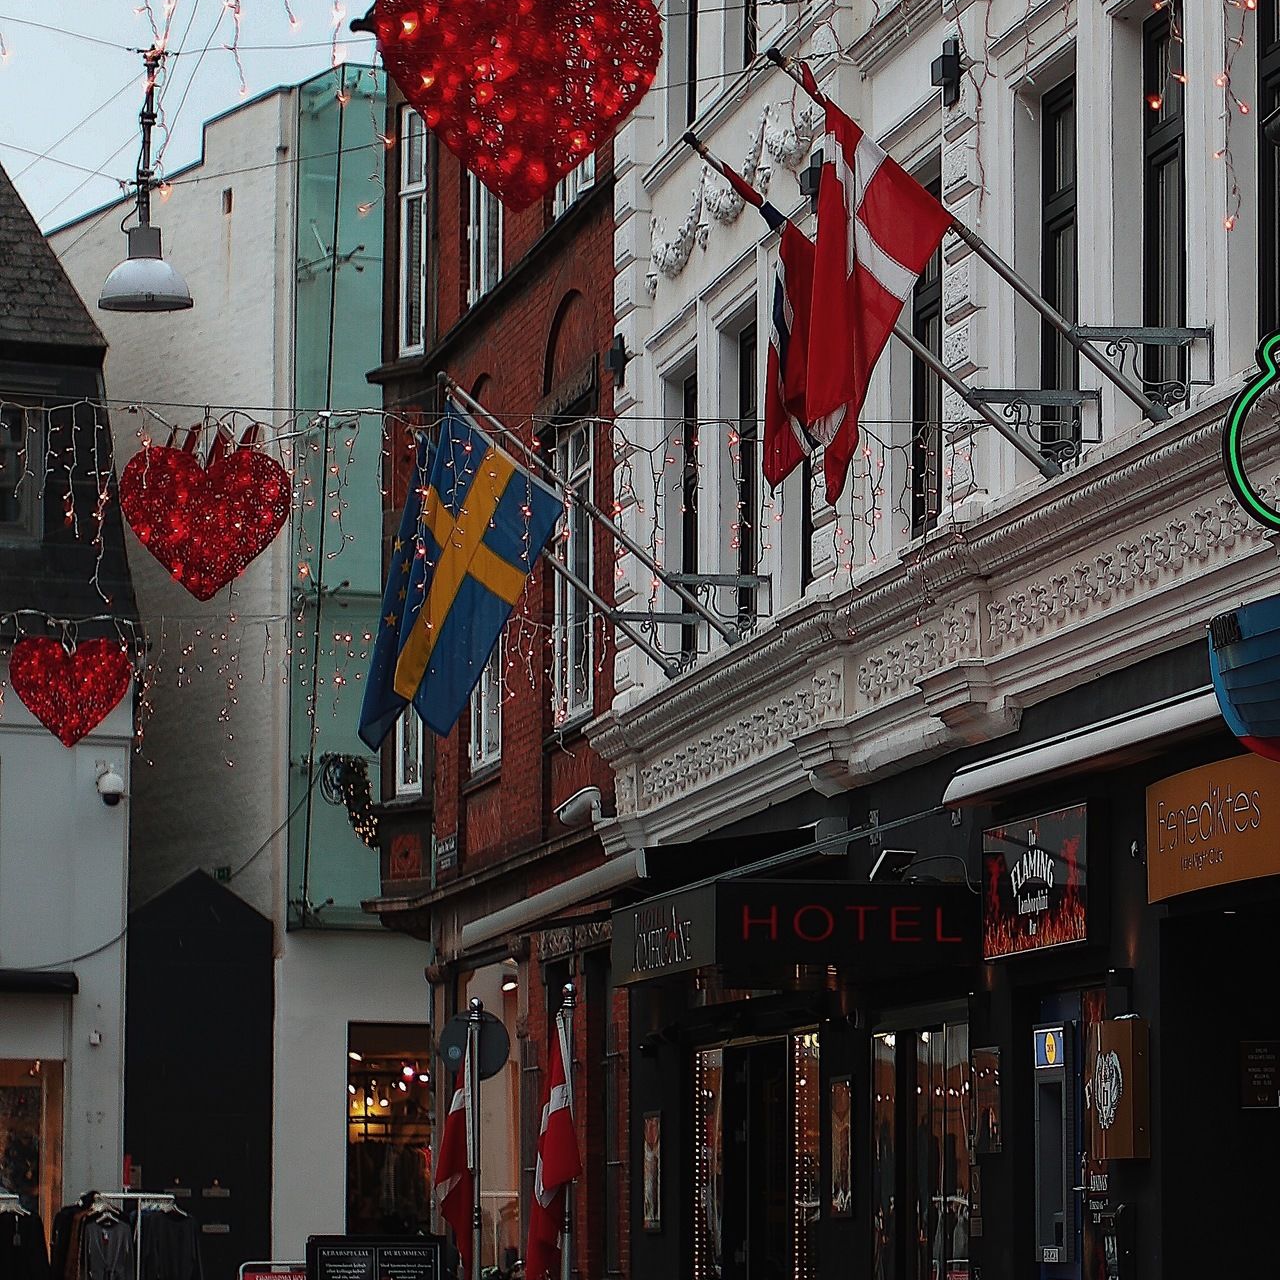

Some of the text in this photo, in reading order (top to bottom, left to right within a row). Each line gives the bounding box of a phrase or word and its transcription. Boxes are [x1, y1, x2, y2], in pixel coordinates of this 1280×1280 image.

[1157, 780, 1262, 853] Benediktes
[1011, 848, 1056, 898] FLAMING
[742, 903, 963, 943] HOTEL
